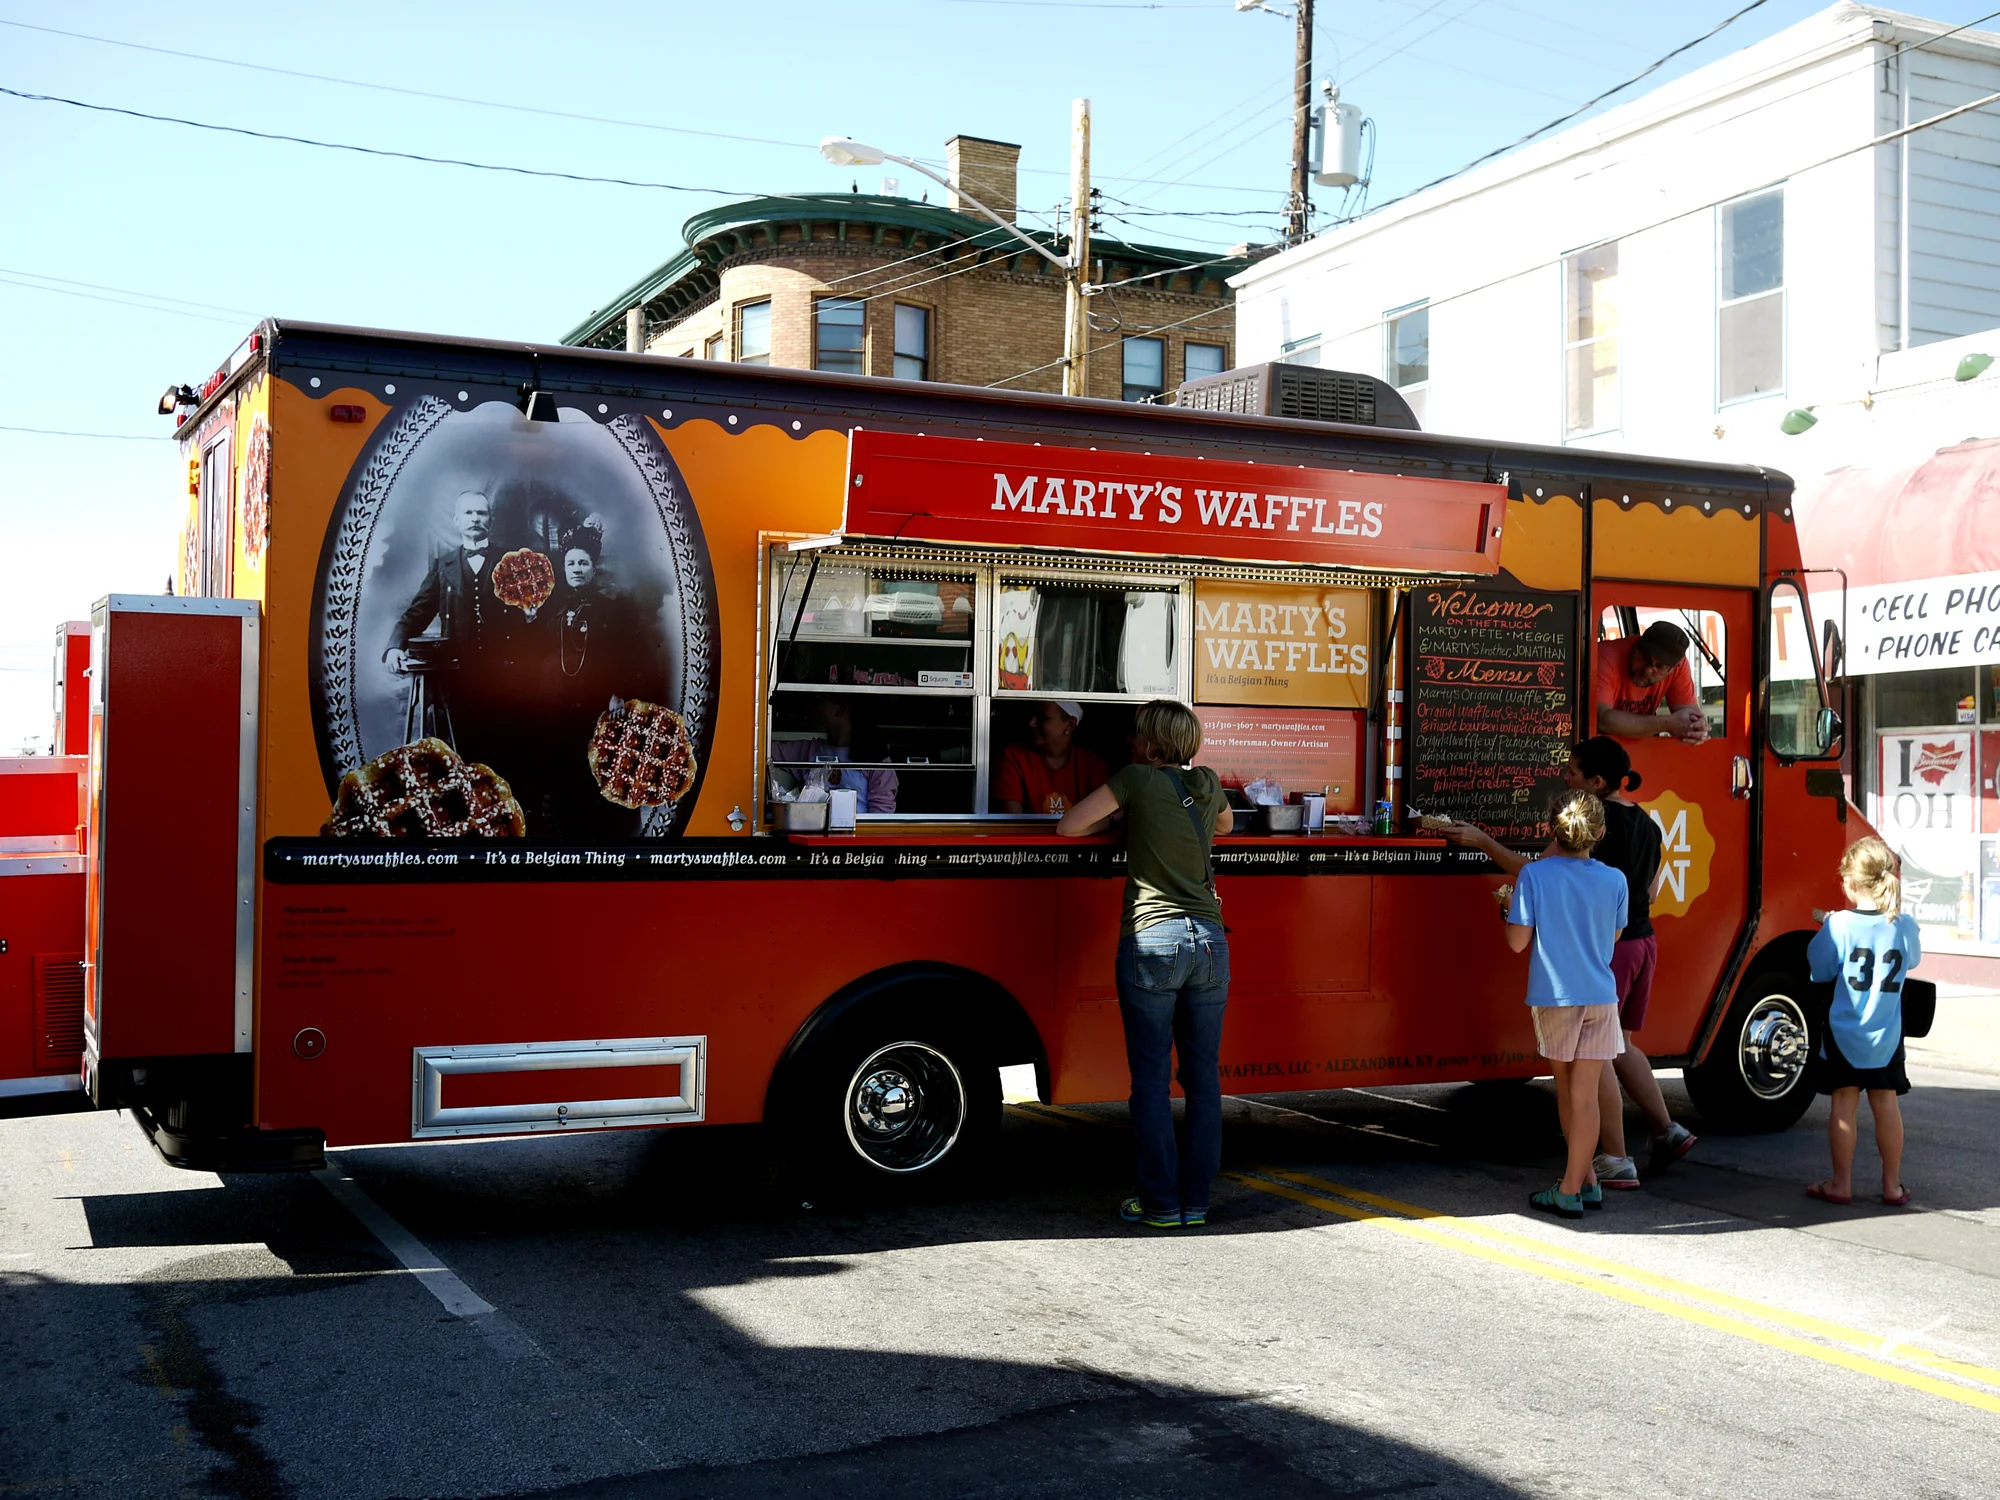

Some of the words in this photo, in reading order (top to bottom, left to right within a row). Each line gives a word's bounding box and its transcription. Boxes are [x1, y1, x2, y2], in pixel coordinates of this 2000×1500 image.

[991, 473, 1182, 524] MARTY'S
[1195, 489, 1383, 538] WAFFLES
[1427, 590, 1553, 619] Welcome
[1873, 593, 1928, 622] CELL
[1195, 600, 1347, 639] MARTY'S
[1447, 618, 1463, 626] ON
[1467, 619, 1490, 627] THE
[1493, 620, 1537, 629] TRUCK:
[1471, 628, 1503, 639] PETE
[1513, 631, 1564, 644] MEGGIE
[1878, 630, 1963, 660] PHONE
[1205, 638, 1369, 675] WAFFLES
[1433, 641, 1480, 655] MARTY'S
[1513, 644, 1566, 660] JONATHAN
[1206, 674, 1219, 684] It's
[1228, 675, 1262, 688] Belgian
[1264, 675, 1289, 688] Thing
[1419, 688, 1460, 704] Marty's
[1461, 689, 1503, 705] Original
[1417, 702, 1456, 720] Original
[1502, 706, 1518, 721] Sea
[1204, 720, 1253, 731] 513/310-3607
[1261, 722, 1325, 732] martyswaffles.com
[1459, 719, 1499, 732] bourbon
[1204, 737, 1227, 747] Marty
[1228, 738, 1270, 748] Meersman,
[1498, 734, 1540, 753] Pumpkin
[1497, 764, 1532, 780] peanut
[1898, 740, 1914, 787] I
[1415, 793, 1446, 808] Extra
[1893, 793, 1955, 829] OH
[1508, 820, 1519, 838] to
[1521, 826, 1532, 840] go
[302, 852, 459, 868] martyswaffles.com
[485, 852, 507, 865] It's
[511, 855, 521, 865] a
[525, 852, 581, 867] Belgian
[585, 852, 626, 866] Thing
[650, 853, 787, 866] martyswaffles.com
[810, 853, 829, 865] It's
[832, 855, 841, 865] a
[845, 853, 885, 867] Belgia
[895, 853, 928, 866] hing
[948, 852, 1069, 866] martyswaffles.com
[1344, 850, 1360, 862] It's
[1362, 853, 1369, 862] a
[1372, 850, 1411, 863] Belgian
[1414, 850, 1442, 863] Thing
[1848, 948, 1903, 992] 32
[1288, 1060, 1312, 1075] LLC
[1324, 1055, 1414, 1072] ALEXANDRIA,
[1416, 1055, 1434, 1068] KY
